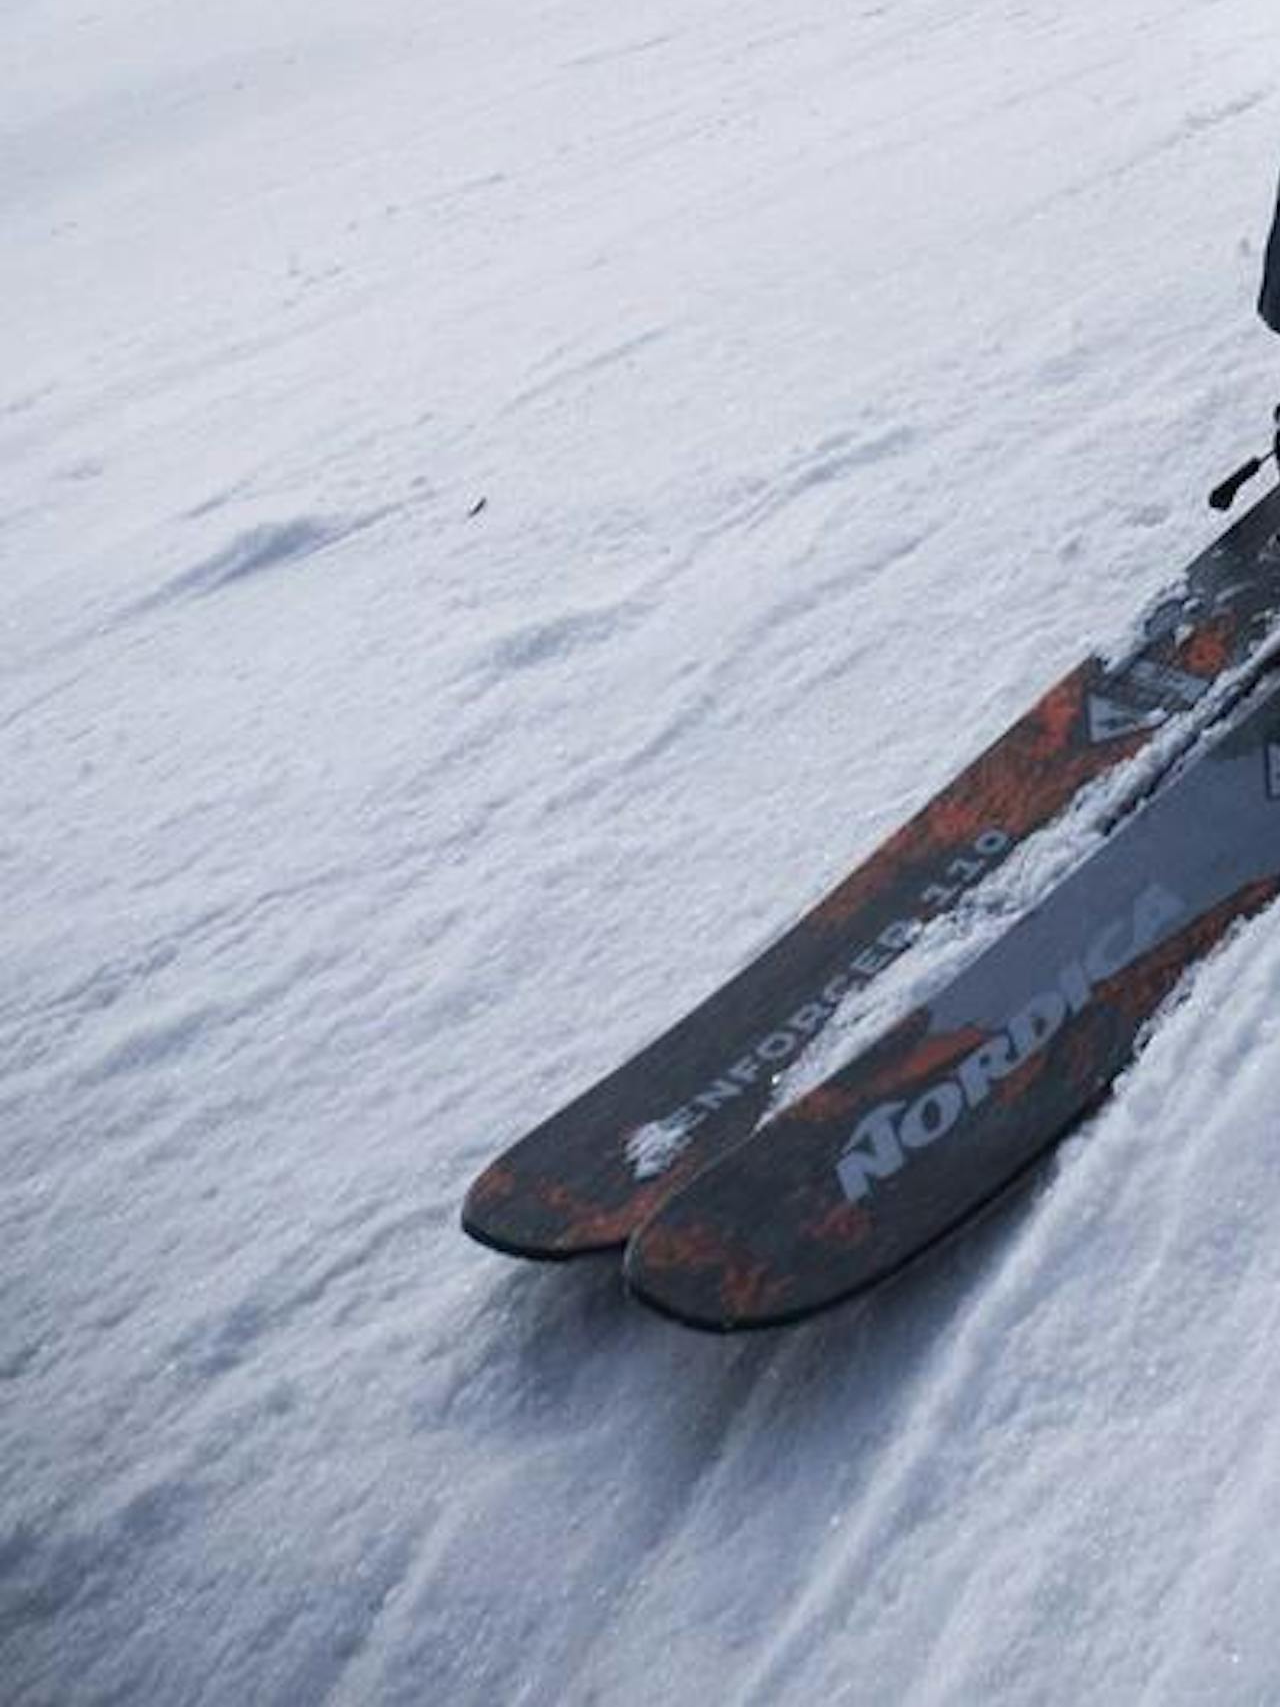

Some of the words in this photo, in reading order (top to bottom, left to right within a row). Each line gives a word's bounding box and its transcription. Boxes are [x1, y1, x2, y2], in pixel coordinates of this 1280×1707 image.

[664, 918, 924, 1138] ENFORCER
[921, 829, 1009, 908] 110
[836, 884, 1187, 1202] NORDICA
